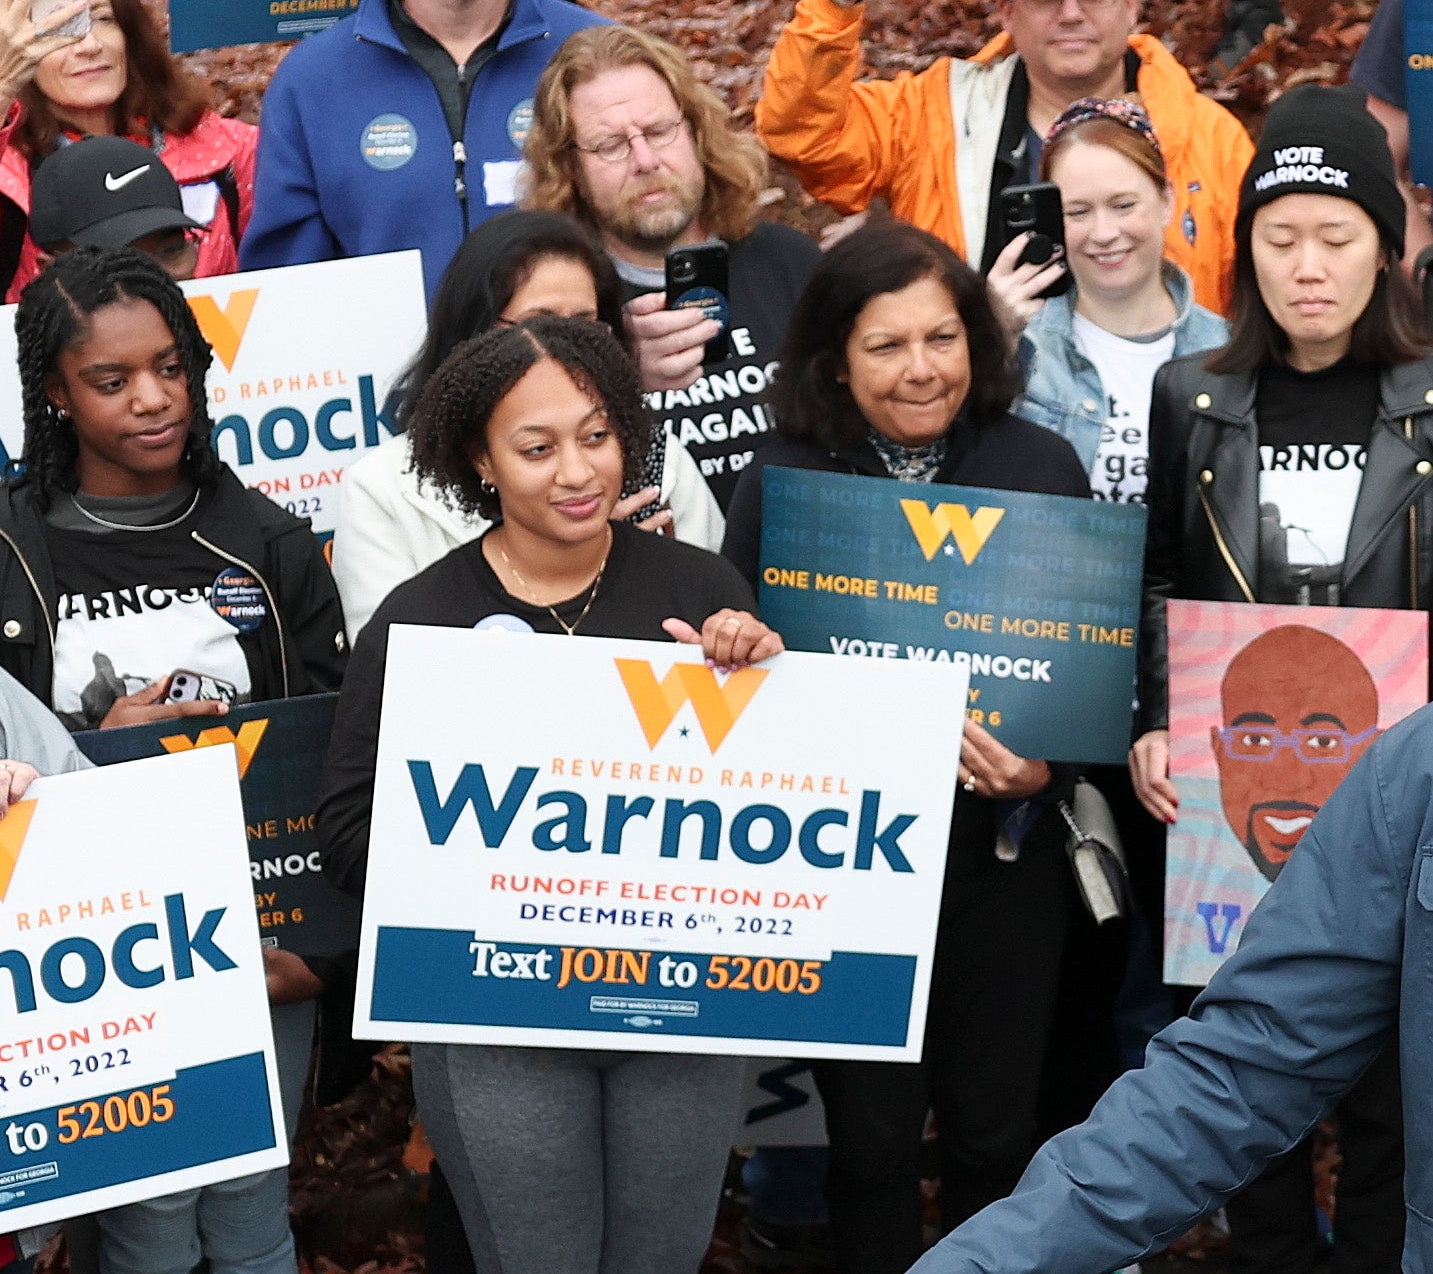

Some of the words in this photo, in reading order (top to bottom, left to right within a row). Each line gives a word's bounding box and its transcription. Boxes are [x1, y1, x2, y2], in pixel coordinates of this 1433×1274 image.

[1274, 146, 1324, 166] VOTE
[1254, 165, 1350, 191] WARNOCK
[240, 368, 348, 401] RAPHAEL
[300, 469, 344, 491] DAY
[763, 568, 809, 589] ONE
[815, 573, 879, 599] MORE
[884, 581, 939, 604] TIME
[944, 611, 996, 635] ONE
[1001, 618, 1071, 641] MORE
[1077, 624, 1134, 646] TIME
[552, 757, 705, 784] REVEREND
[721, 769, 851, 795] RAPHAEL
[407, 760, 920, 874] Warnock
[490, 873, 609, 898] RUNOFF
[620, 882, 762, 908] ELECTION
[773, 890, 829, 911] DAY
[16, 889, 151, 931] RAPHAEL
[520, 903, 673, 929] DECEMBER
[735, 916, 794, 936] 2022
[469, 942, 553, 982] Text
[559, 947, 652, 988] JOIN
[658, 954, 697, 988] to
[705, 958, 821, 994] 52005
[101, 1012, 159, 1041] DAY
[71, 1048, 132, 1078] 2022
[6, 1121, 48, 1157] to
[56, 1084, 176, 1144] 52005
